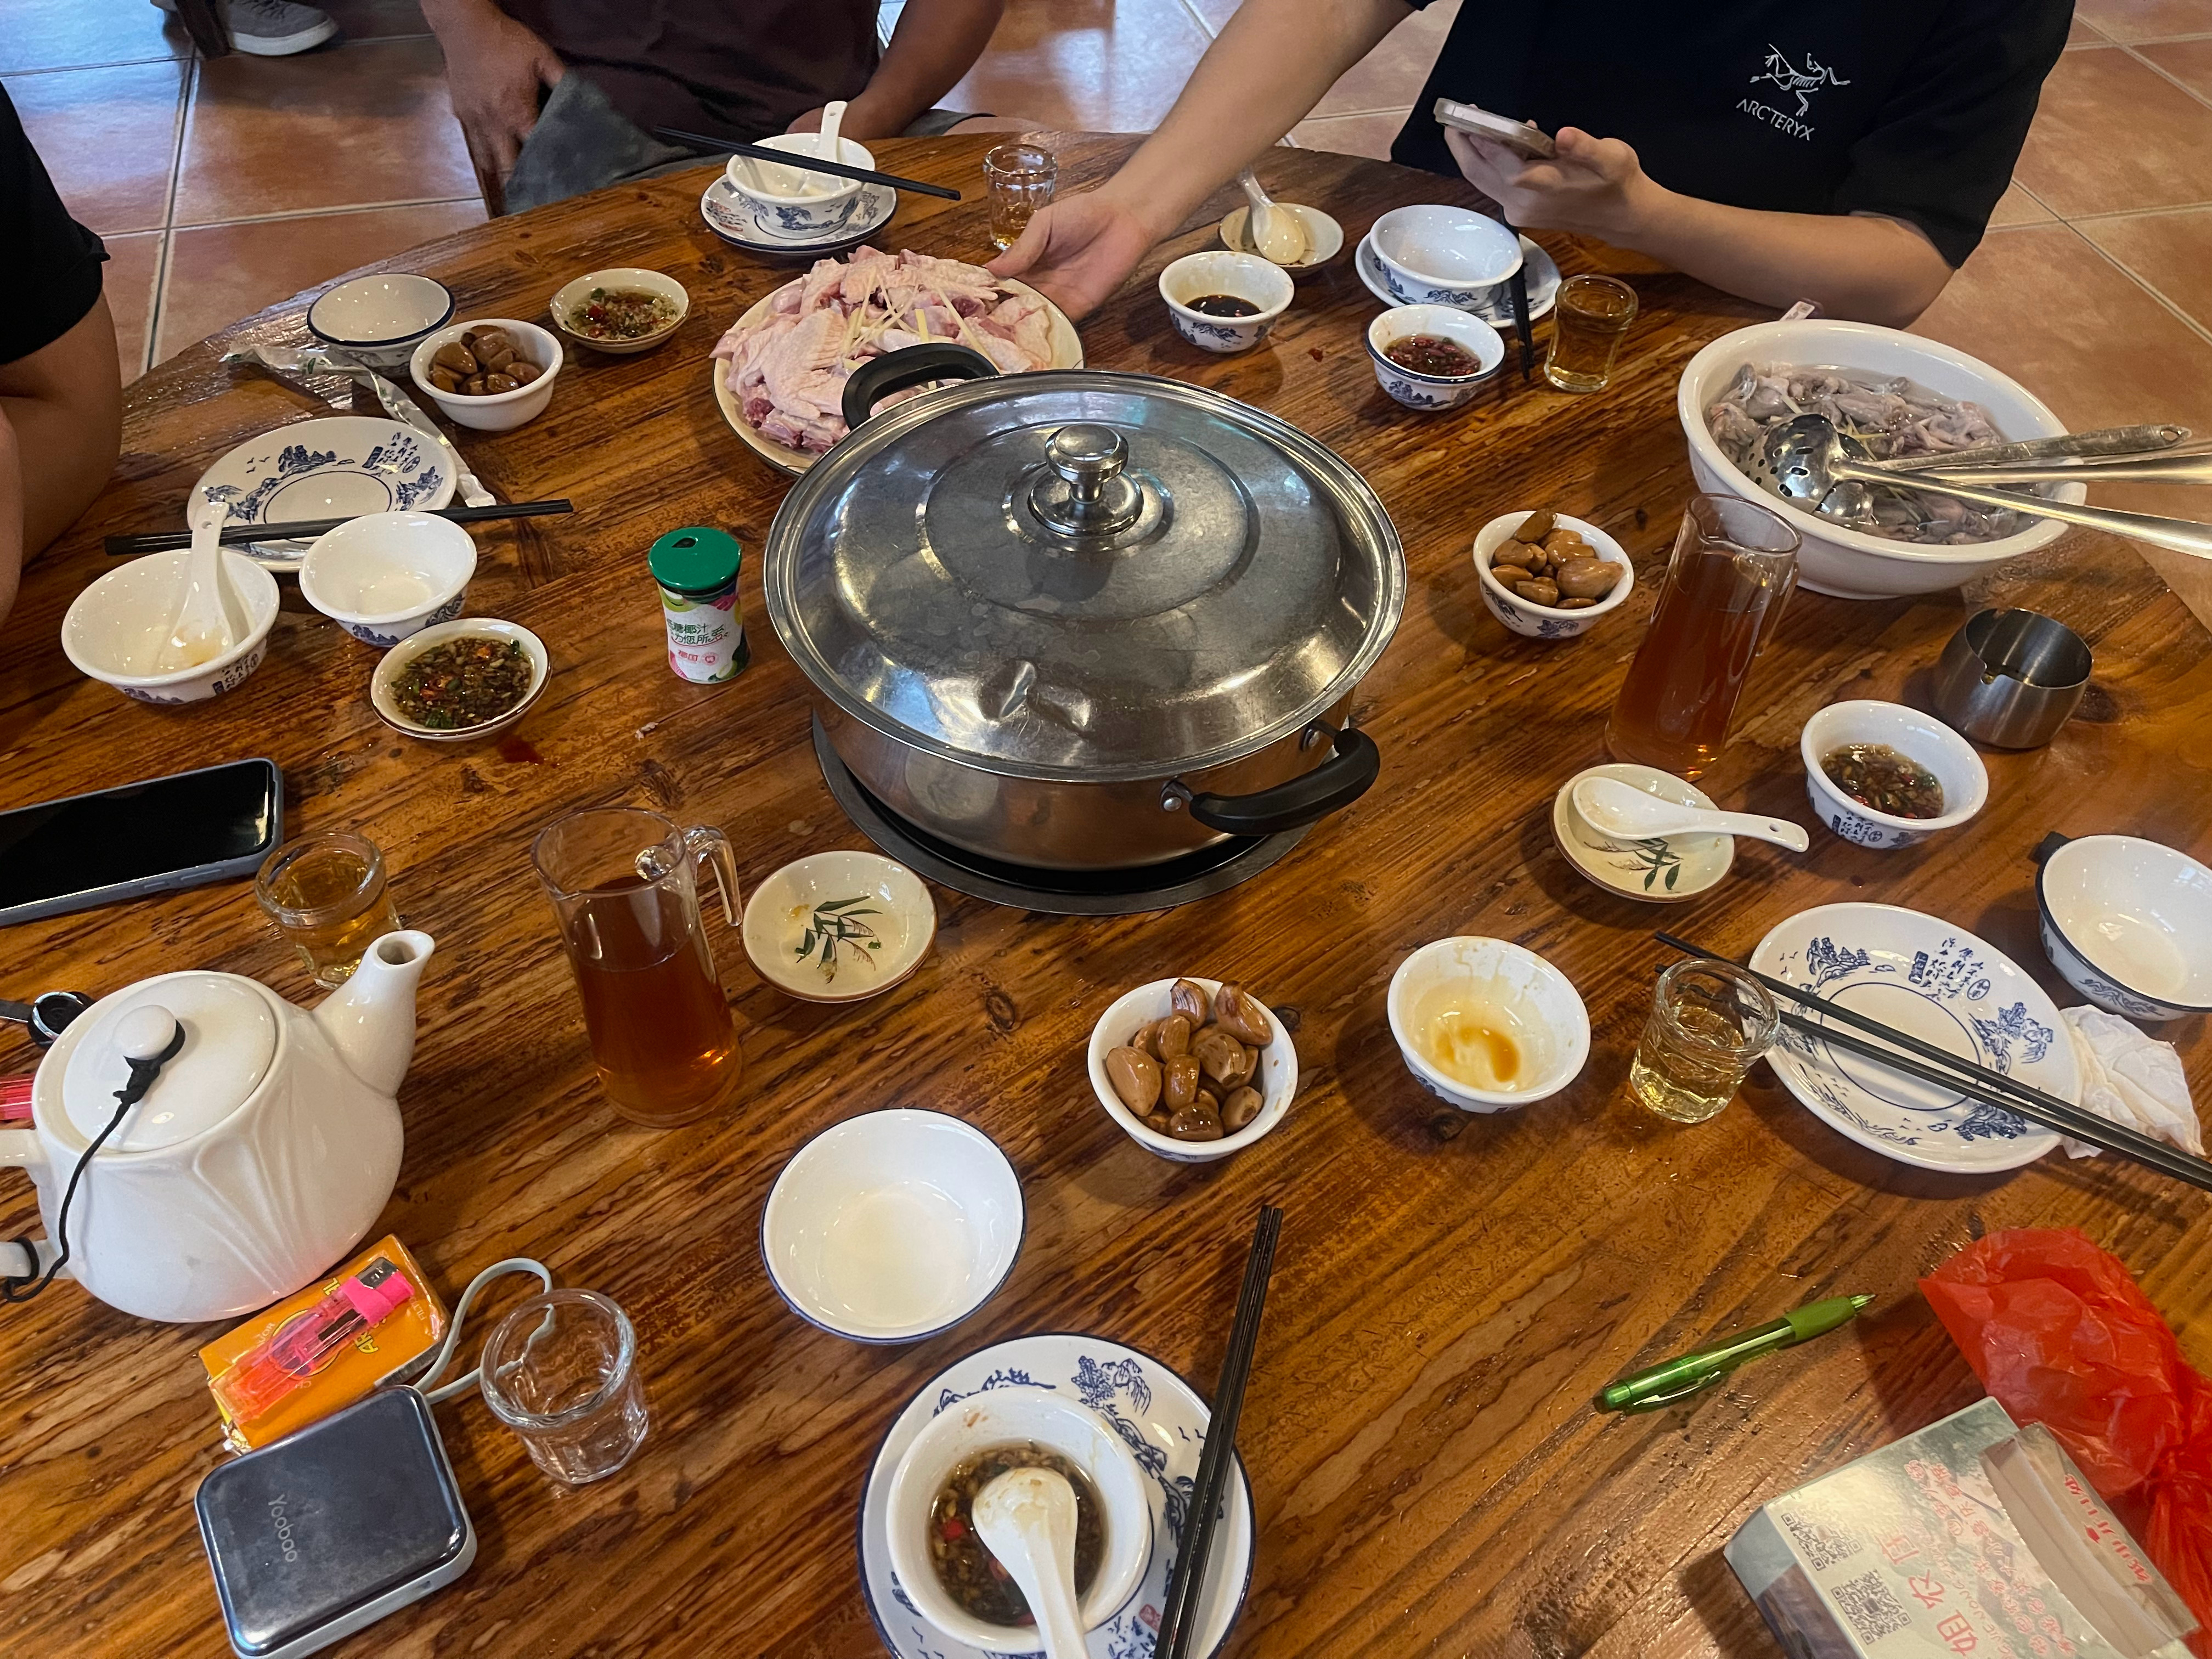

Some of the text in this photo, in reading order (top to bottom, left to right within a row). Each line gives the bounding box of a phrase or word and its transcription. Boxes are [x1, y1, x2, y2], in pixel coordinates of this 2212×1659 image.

[268, 1494, 298, 1562] Yoobao
[2064, 1474, 2152, 1582] 纸巾开口处
